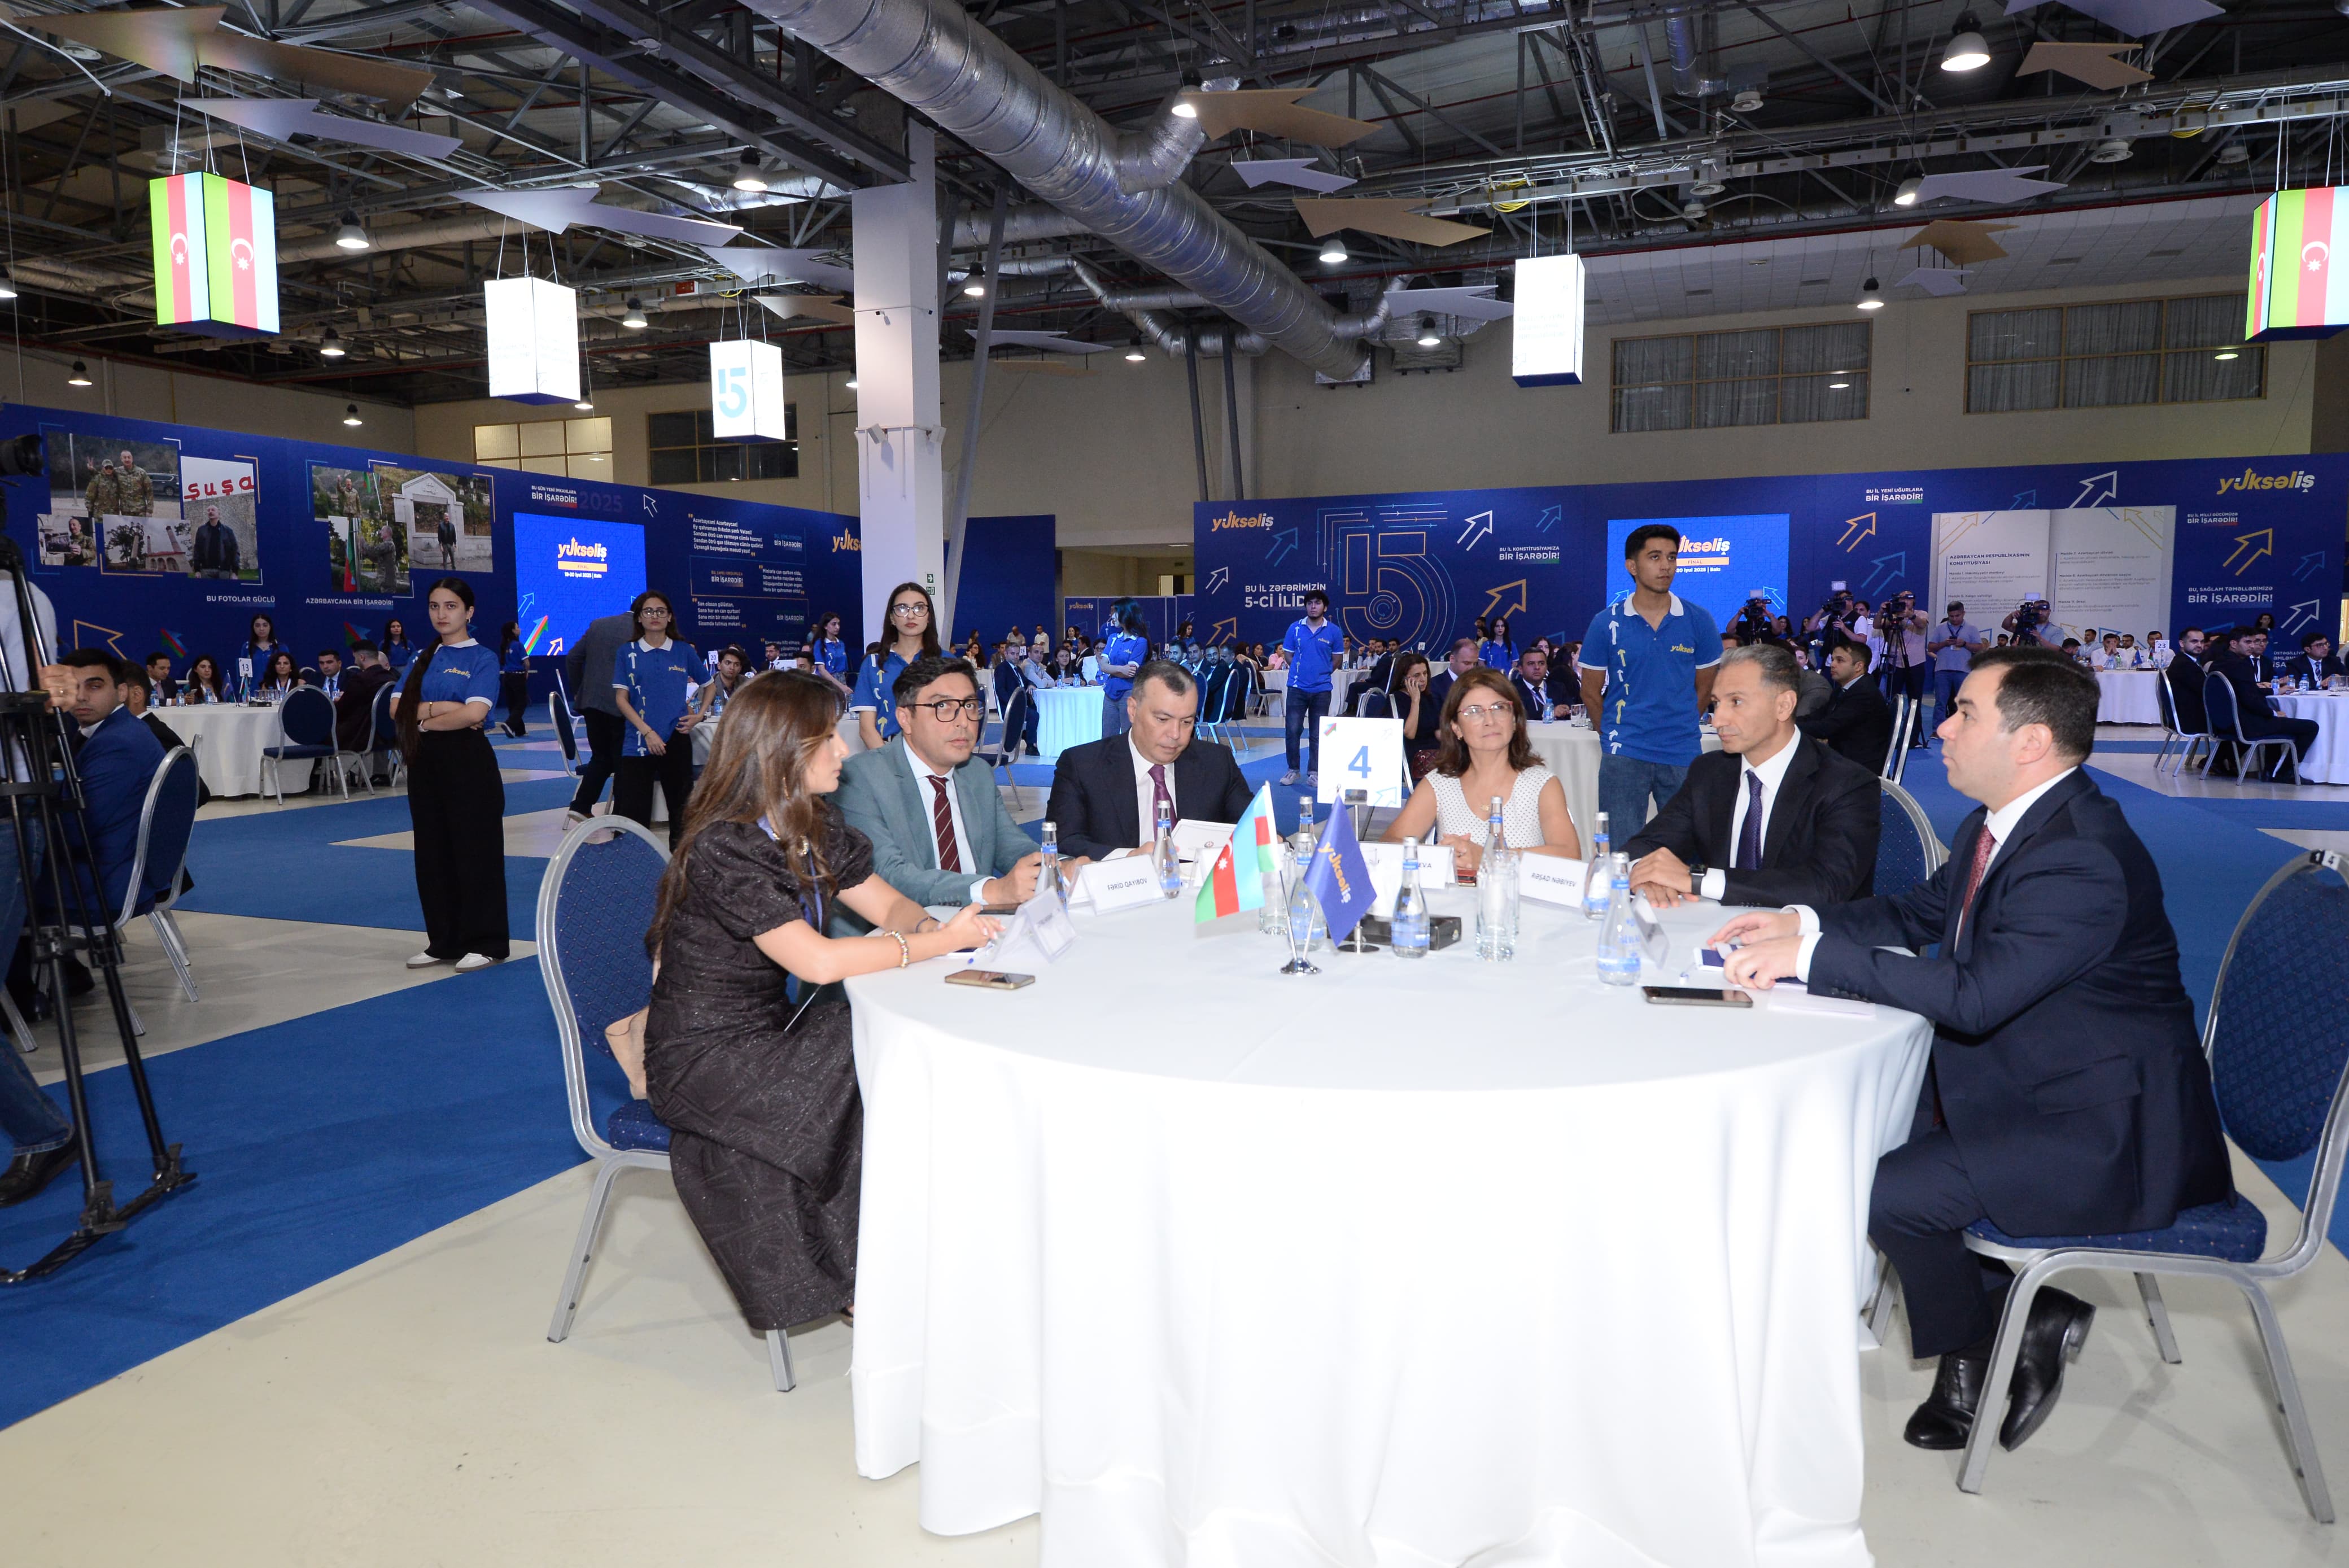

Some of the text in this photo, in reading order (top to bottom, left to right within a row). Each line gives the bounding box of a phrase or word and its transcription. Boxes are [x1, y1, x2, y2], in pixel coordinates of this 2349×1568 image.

[2216, 468, 2315, 495] yüksəliş
[532, 491, 577, 504] BİR İŞARƏDİR!
[1881, 492, 1923, 502] İŞARƏDİR!
[1212, 510, 1274, 532] yüksəliş
[557, 536, 607, 562] yüksəliş
[781, 539, 802, 548] İŞARƏDİR!
[1516, 551, 1560, 561] İŞARƏDİR!
[1259, 583, 1267, 592] İL
[1269, 582, 1326, 592] ZƏFƏRİMİZİN
[1245, 593, 1305, 608] 5-Cİ İLİD
[2188, 592, 2273, 604] BİR İŞARƏDİR!
[1348, 745, 1372, 779] 4
[1317, 842, 1351, 903] yüksəliş
[1124, 877, 1147, 887] QAYIBOV
